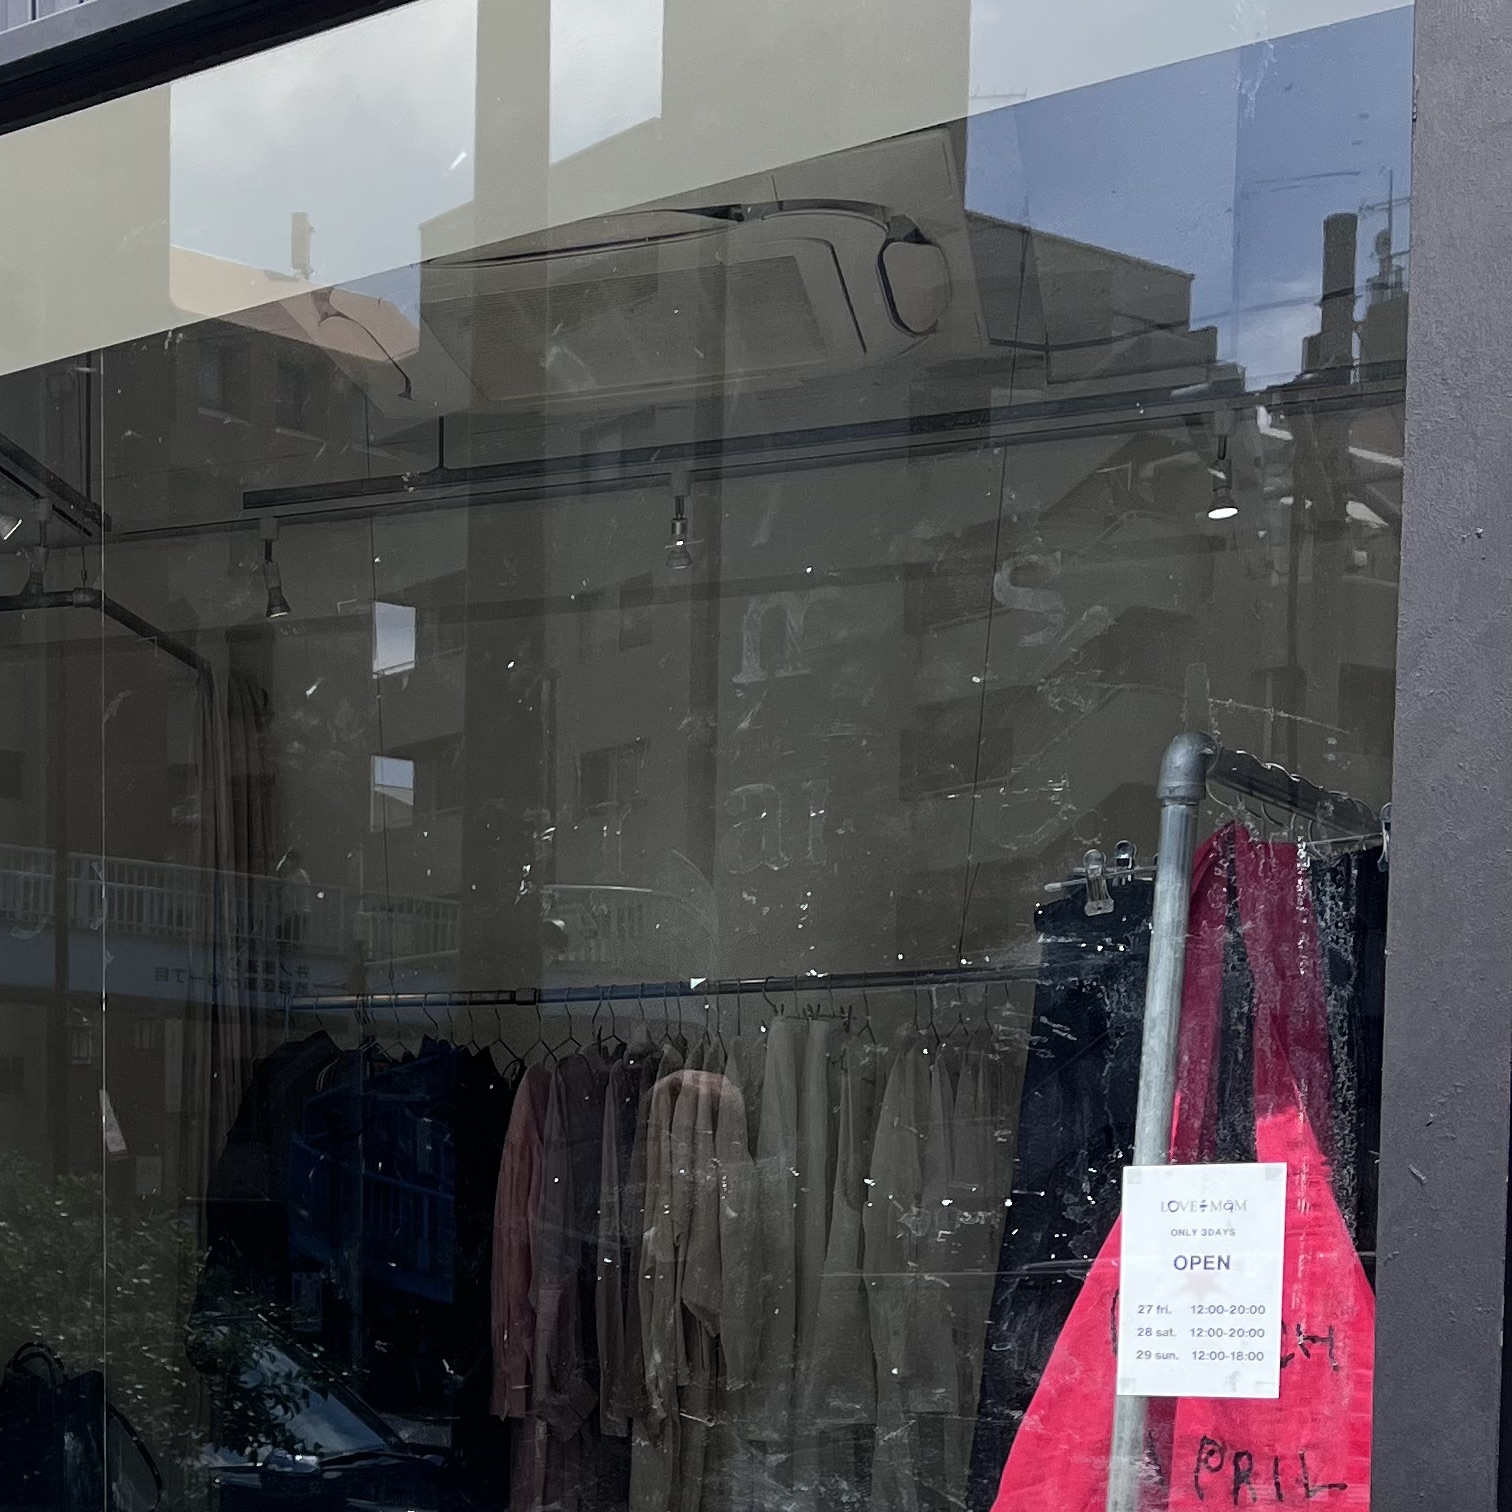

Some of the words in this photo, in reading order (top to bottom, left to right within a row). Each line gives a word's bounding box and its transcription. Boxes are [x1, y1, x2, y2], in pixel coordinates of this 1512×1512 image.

[1170, 1228, 1198, 1237] ONLY
[1201, 1228, 1236, 1237] 3DAYS
[1173, 1254, 1232, 1271] OPEN
[1137, 1304, 1155, 1315] 27
[1156, 1304, 1173, 1315] fri.
[1189, 1304, 1266, 1315] 12:00-20:00
[1136, 1327, 1153, 1338] 28
[1156, 1327, 1178, 1338] sat.
[1189, 1327, 1266, 1338] 12:00-20:00
[1135, 1350, 1152, 1361] 29
[1155, 1351, 1180, 1361] sun.
[1191, 1350, 1265, 1362] 12:00-18:00
